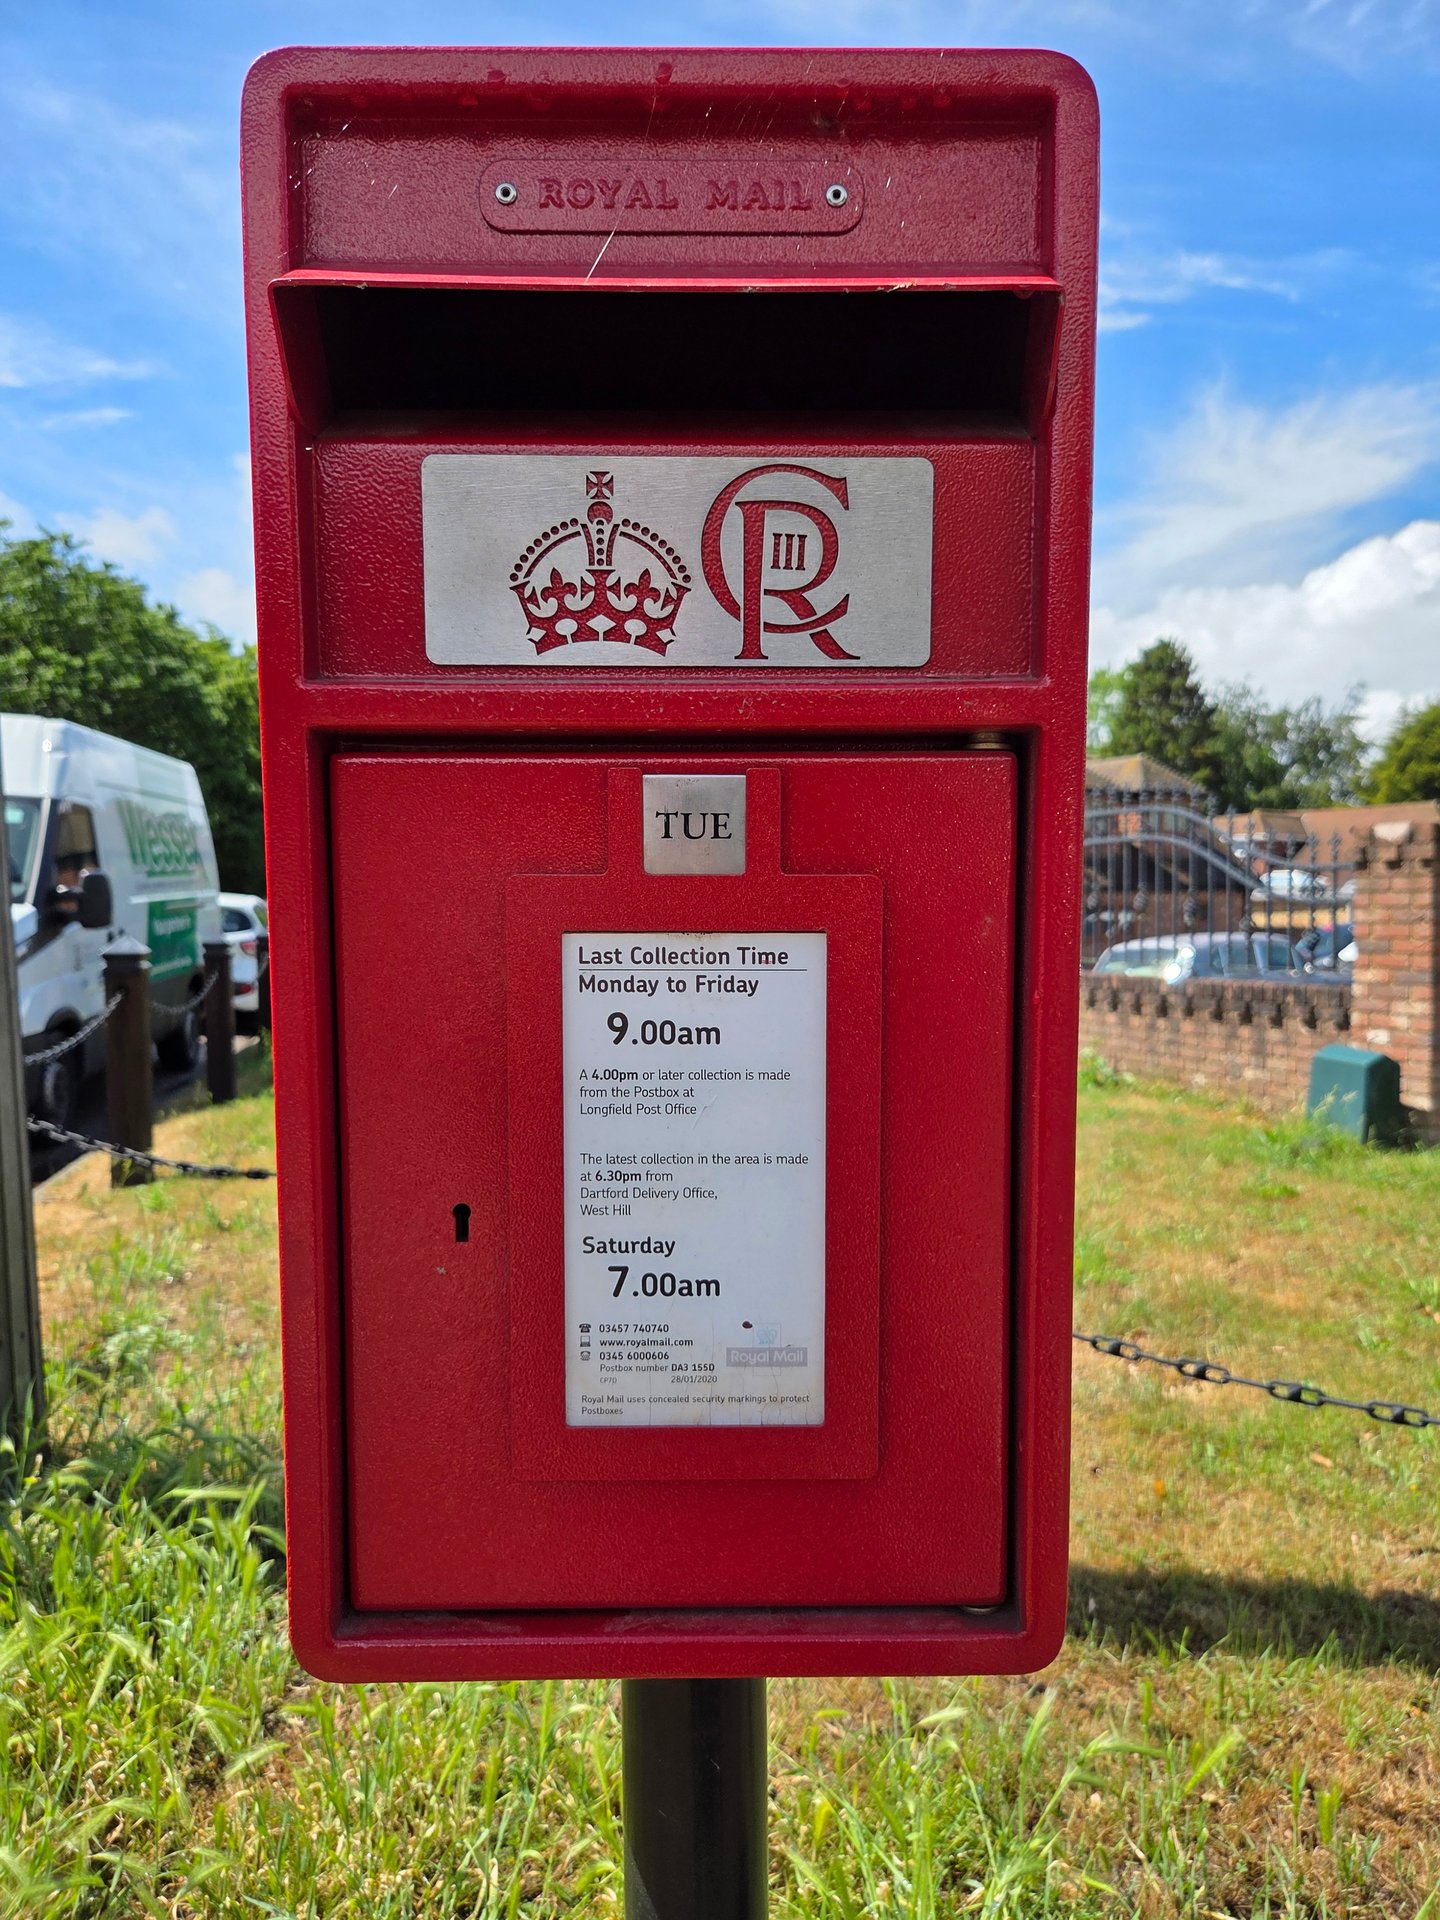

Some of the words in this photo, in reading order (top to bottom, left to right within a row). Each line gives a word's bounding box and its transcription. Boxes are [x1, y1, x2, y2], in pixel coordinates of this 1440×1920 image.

[538, 177, 679, 210] ROYAL
[704, 179, 812, 212] MAIL
[655, 810, 733, 840] TUE
[578, 945, 624, 965] Last
[630, 946, 730, 965] Collection
[736, 946, 789, 966] Time
[578, 974, 660, 998] Monday
[665, 976, 687, 994] to
[695, 974, 760, 998] Friday
[606, 1011, 721, 1046] 9.00am
[579, 1068, 589, 1081] A
[591, 1068, 639, 1083] 4.00pm
[642, 1071, 656, 1081] or
[658, 1068, 685, 1081] later
[687, 1068, 742, 1081] collection
[745, 1068, 755, 1081] is
[757, 1068, 791, 1081] made
[579, 1085, 608, 1098] from
[611, 1085, 631, 1098] the
[634, 1085, 680, 1098] Postbox
[682, 1086, 695, 1098] at
[580, 1102, 633, 1118] Longfield
[636, 1102, 662, 1115] Post
[664, 1102, 697, 1115] Office
[579, 1152, 603, 1165] The
[605, 1152, 638, 1165] latest
[640, 1152, 694, 1165] collection
[697, 1152, 709, 1165] in
[711, 1152, 731, 1165] the
[734, 1155, 760, 1165] area
[763, 1152, 773, 1165] is
[775, 1152, 809, 1165] made
[580, 1171, 592, 1182] at
[595, 1169, 642, 1185] 6.30pm
[645, 1169, 673, 1182] from
[580, 1186, 629, 1199] Dartford
[632, 1186, 680, 1202] Delivery
[682, 1186, 718, 1201] Office,
[579, 1203, 610, 1216] West
[612, 1203, 632, 1216] Hill
[582, 1235, 676, 1258] Saturday
[607, 1265, 721, 1298] 7.00am
[598, 1323, 630, 1334] 03457
[632, 1323, 670, 1334] 740740
[599, 1337, 694, 1349] www.royalmail.com
[599, 1351, 624, 1361] 0345
[626, 1351, 670, 1361] 6000606
[730, 1350, 770, 1365] Royal
[773, 1350, 804, 1363] Mail
[599, 1363, 633, 1373] Postbox
[635, 1363, 669, 1373] number
[671, 1363, 689, 1372] DA3
[670, 1374, 718, 1384] 28/01/2020
[581, 1394, 604, 1405] Royal
[606, 1394, 625, 1404] Mail
[626, 1396, 646, 1404] uses
[648, 1394, 690, 1404] concealed
[692, 1394, 726, 1405] security
[727, 1394, 768, 1405] markings
[769, 1394, 778, 1403] to
[780, 1394, 810, 1405] protect
[581, 1406, 624, 1416] Postboxes
